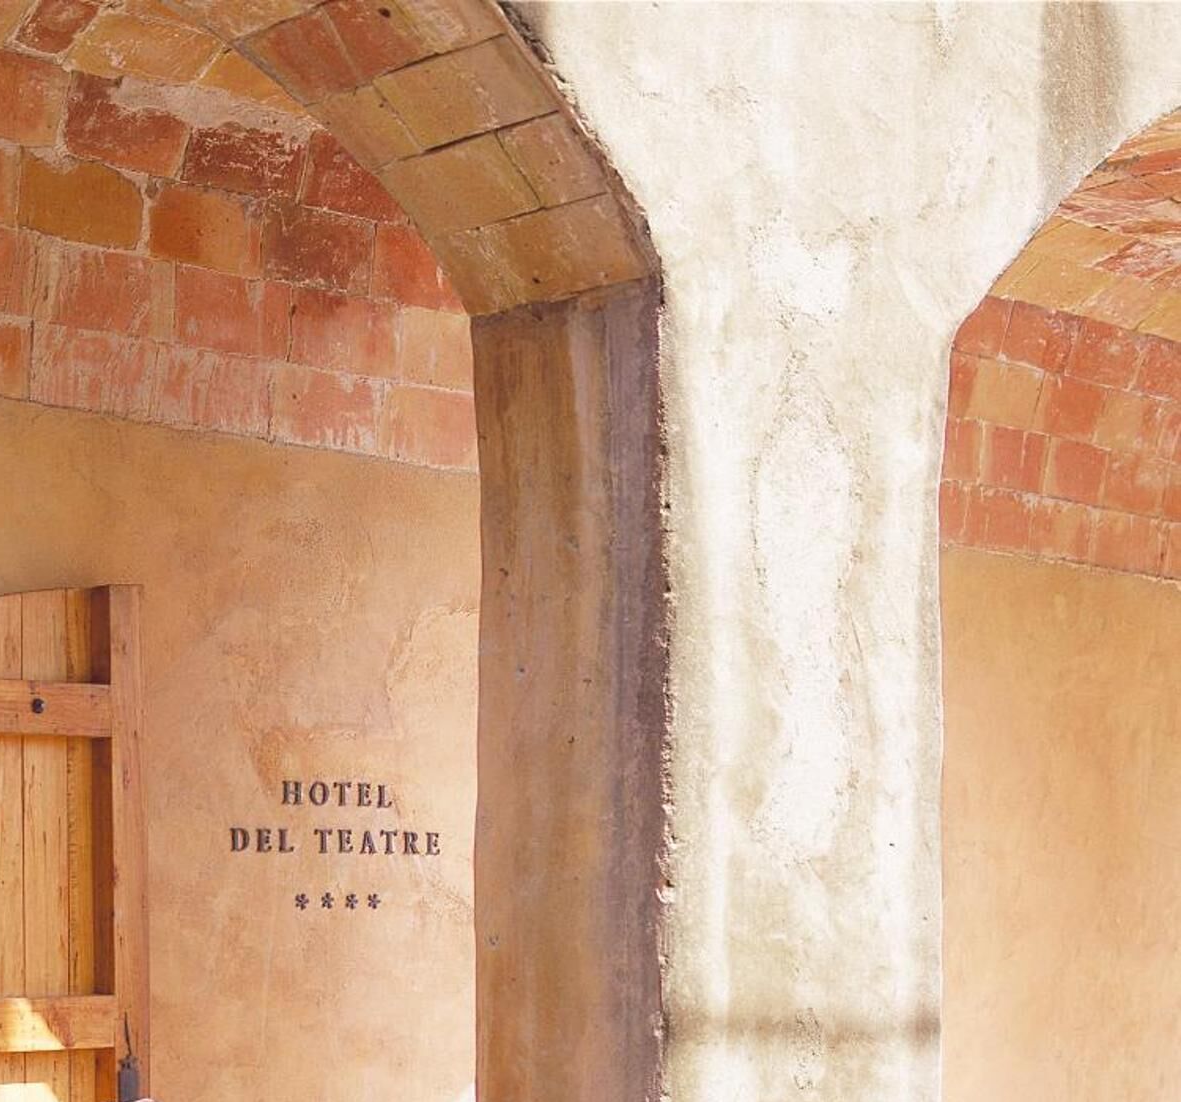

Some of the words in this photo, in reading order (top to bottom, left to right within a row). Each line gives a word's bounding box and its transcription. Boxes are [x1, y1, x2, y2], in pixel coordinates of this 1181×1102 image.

[281, 779, 394, 809] HOTEL
[229, 827, 295, 854] DEL
[313, 828, 442, 856] TEATRE
